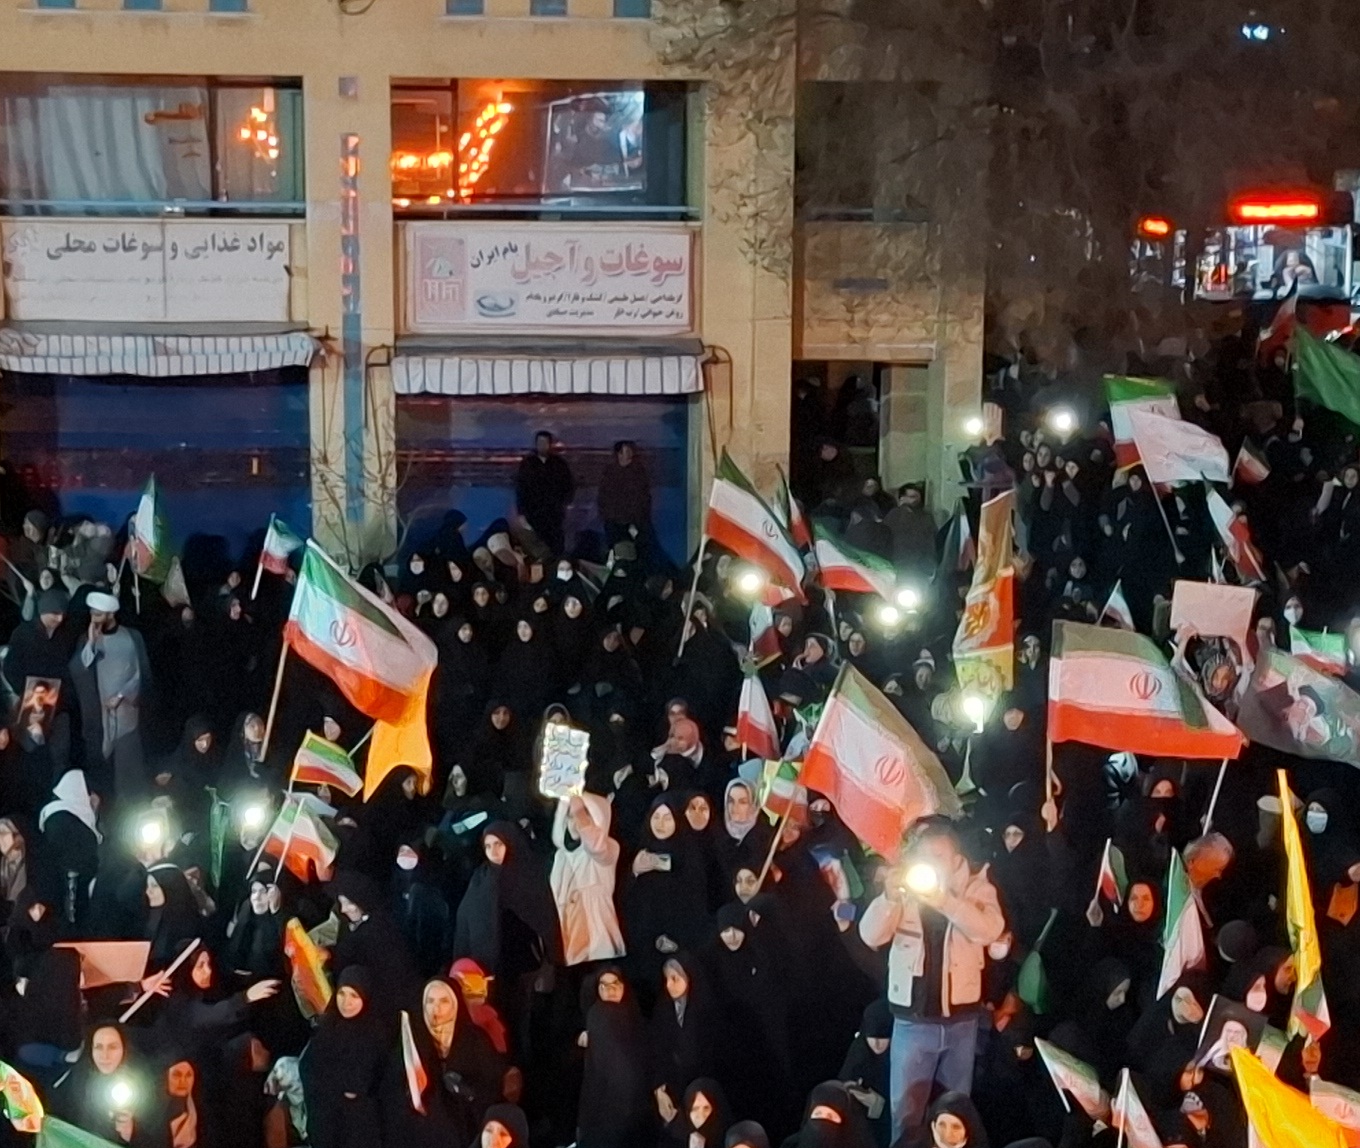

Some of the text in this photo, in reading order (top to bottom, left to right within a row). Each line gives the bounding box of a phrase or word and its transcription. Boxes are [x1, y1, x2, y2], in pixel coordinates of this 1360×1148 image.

[46, 232, 97, 260] محلی
[102, 233, 165, 261] سوغات
[169, 242, 179, 260] و
[184, 231, 241, 260] غذایی
[247, 232, 285, 260] مواد
[470, 246, 502, 269] ایران
[511, 239, 684, 286] سوغات و آجیل
